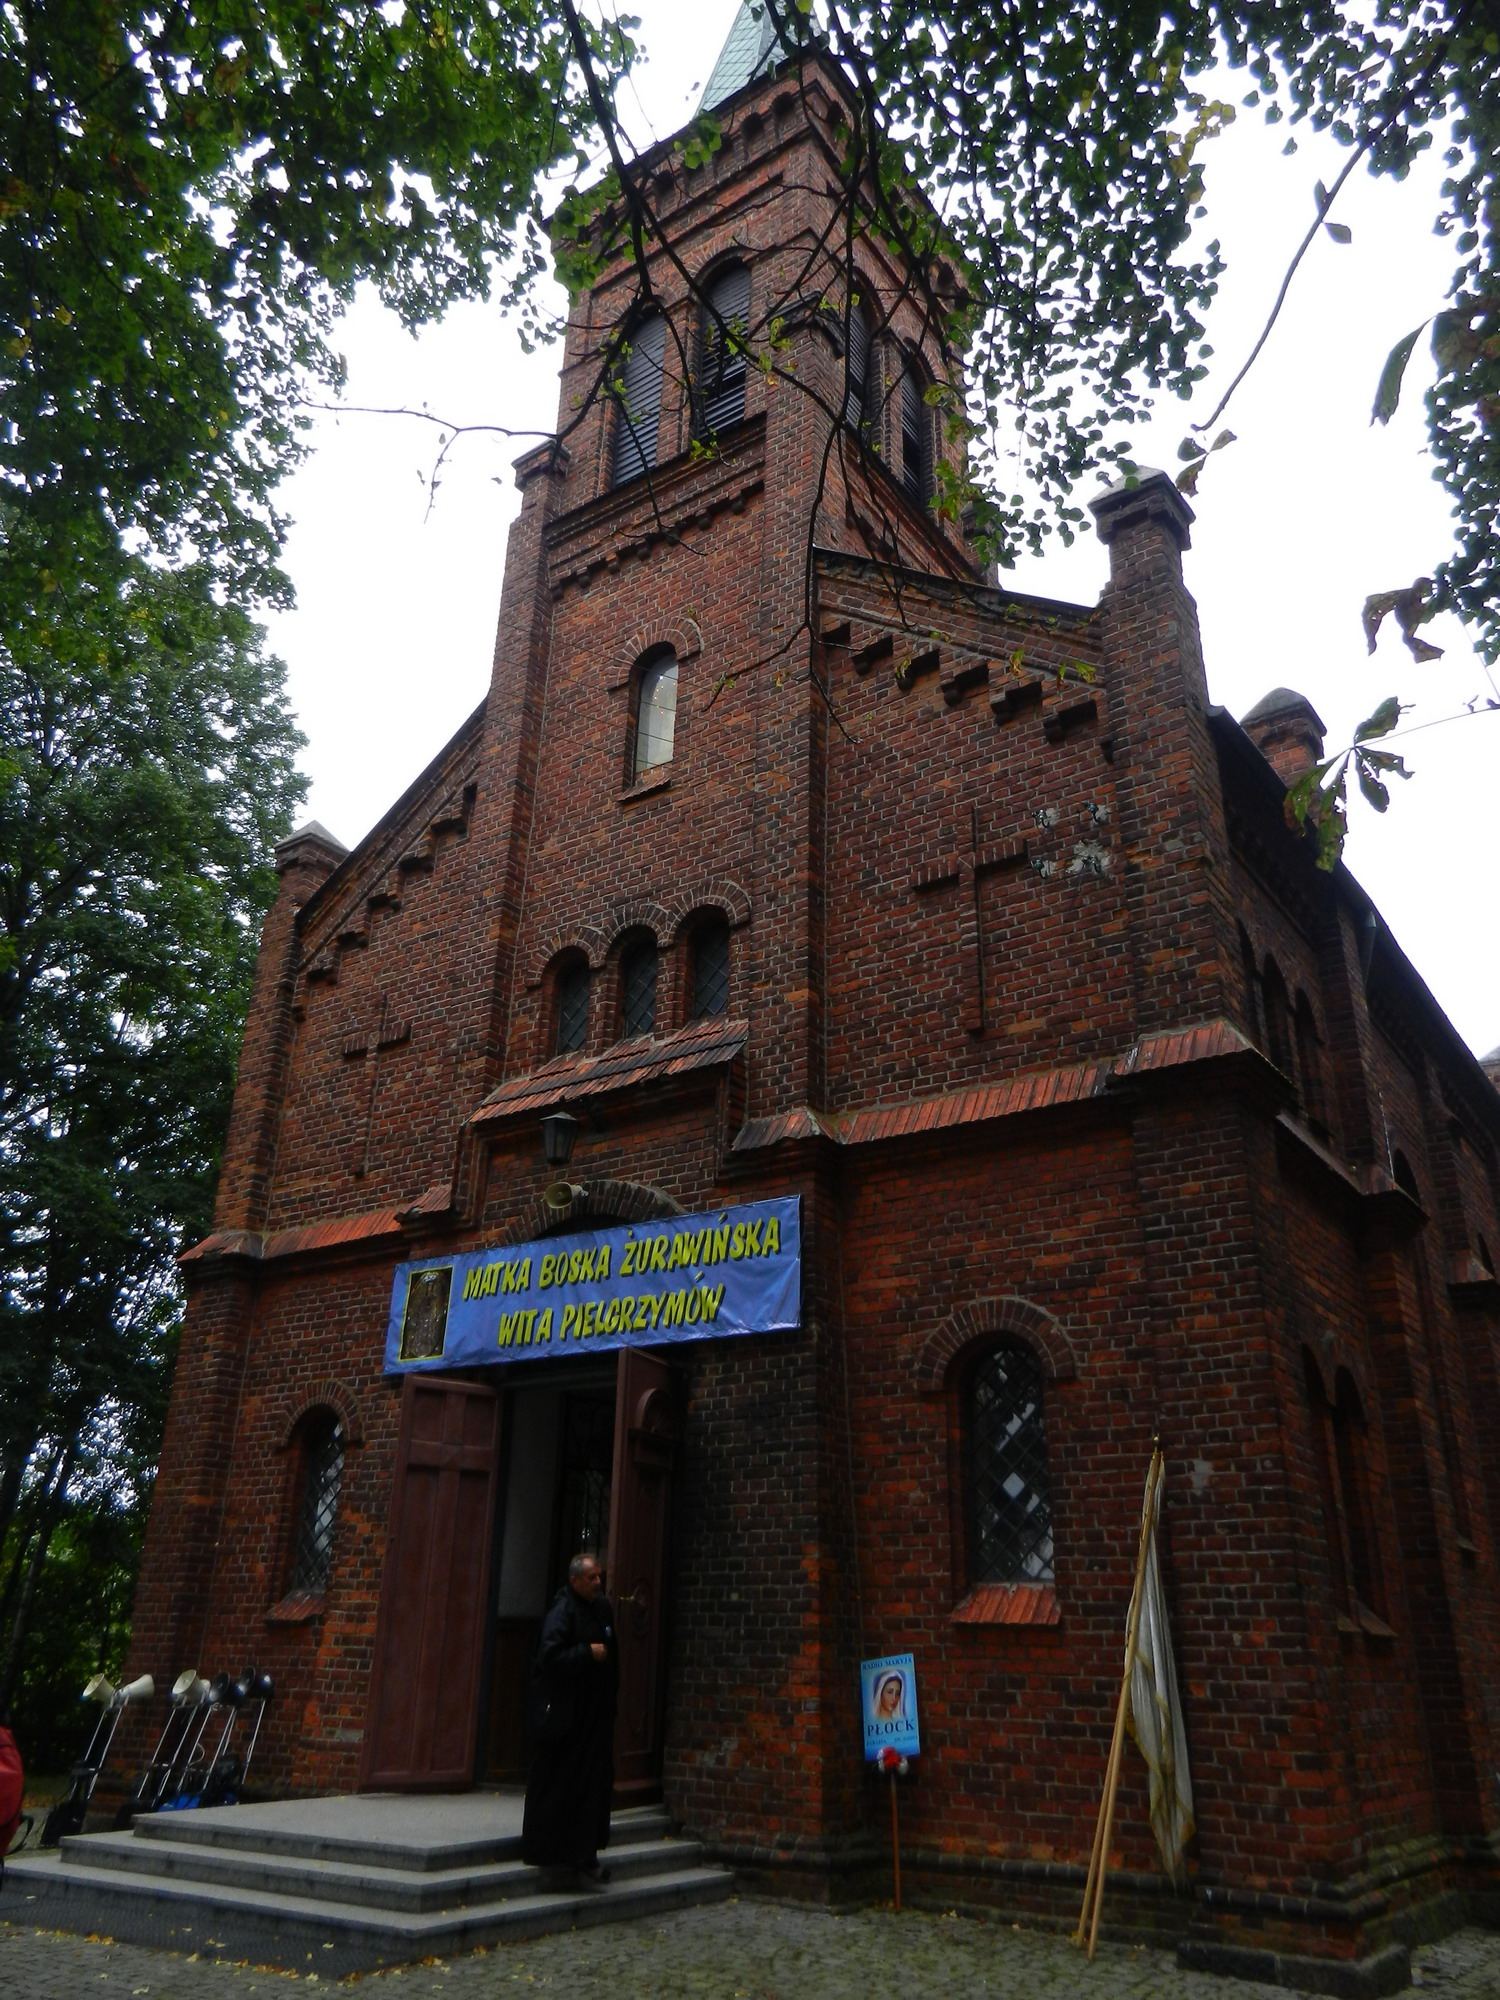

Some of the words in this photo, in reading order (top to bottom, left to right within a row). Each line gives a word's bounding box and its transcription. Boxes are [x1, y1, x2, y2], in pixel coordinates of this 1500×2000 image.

[462, 1256, 531, 1301] MATKA
[539, 1244, 612, 1290] BOSKA
[619, 1212, 781, 1276] ŻURAWIŃSKA
[498, 1307, 553, 1347] WITA
[560, 1271, 725, 1340] PIELGRZYMÓW
[867, 1719, 915, 1737] PŁOCK
